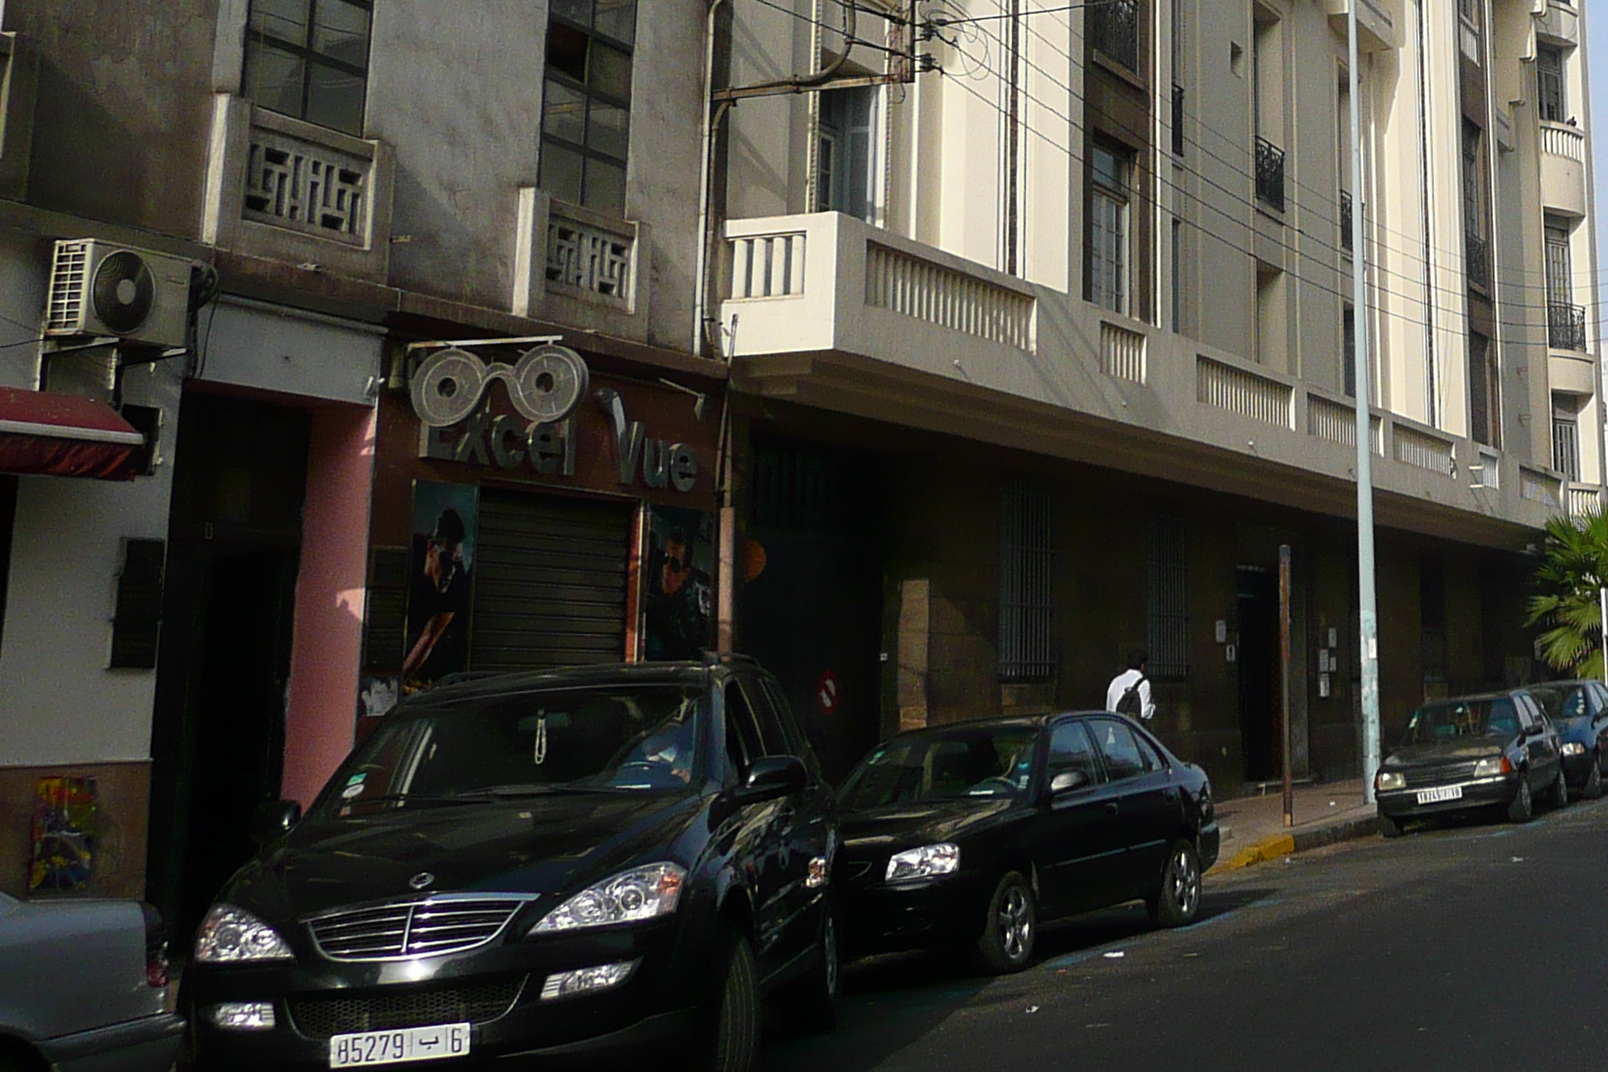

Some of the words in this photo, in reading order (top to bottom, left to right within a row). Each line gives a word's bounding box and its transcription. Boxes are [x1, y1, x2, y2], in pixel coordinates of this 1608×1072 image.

[596, 387, 699, 493] Vue
[338, 1033, 404, 1064] 85279
[451, 1028, 462, 1053] 6
